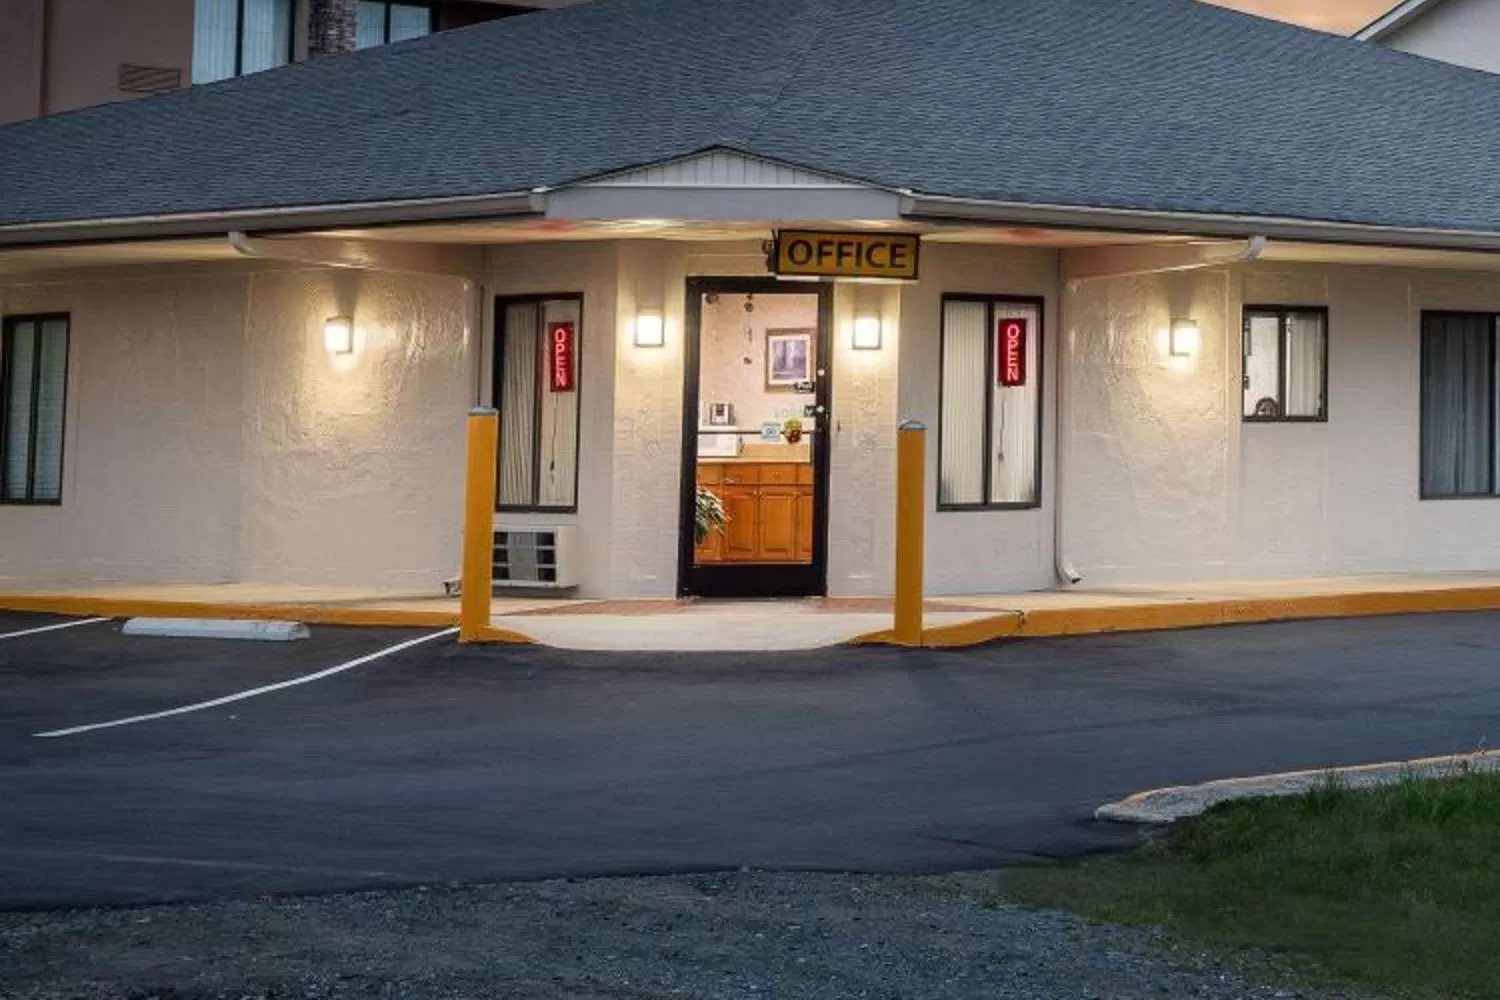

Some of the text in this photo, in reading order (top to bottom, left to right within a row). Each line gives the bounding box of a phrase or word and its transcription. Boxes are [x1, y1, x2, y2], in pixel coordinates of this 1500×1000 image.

[787, 239, 908, 268] OFFICE
[555, 327, 567, 387] OPEN
[1007, 324, 1020, 381] OPEN
